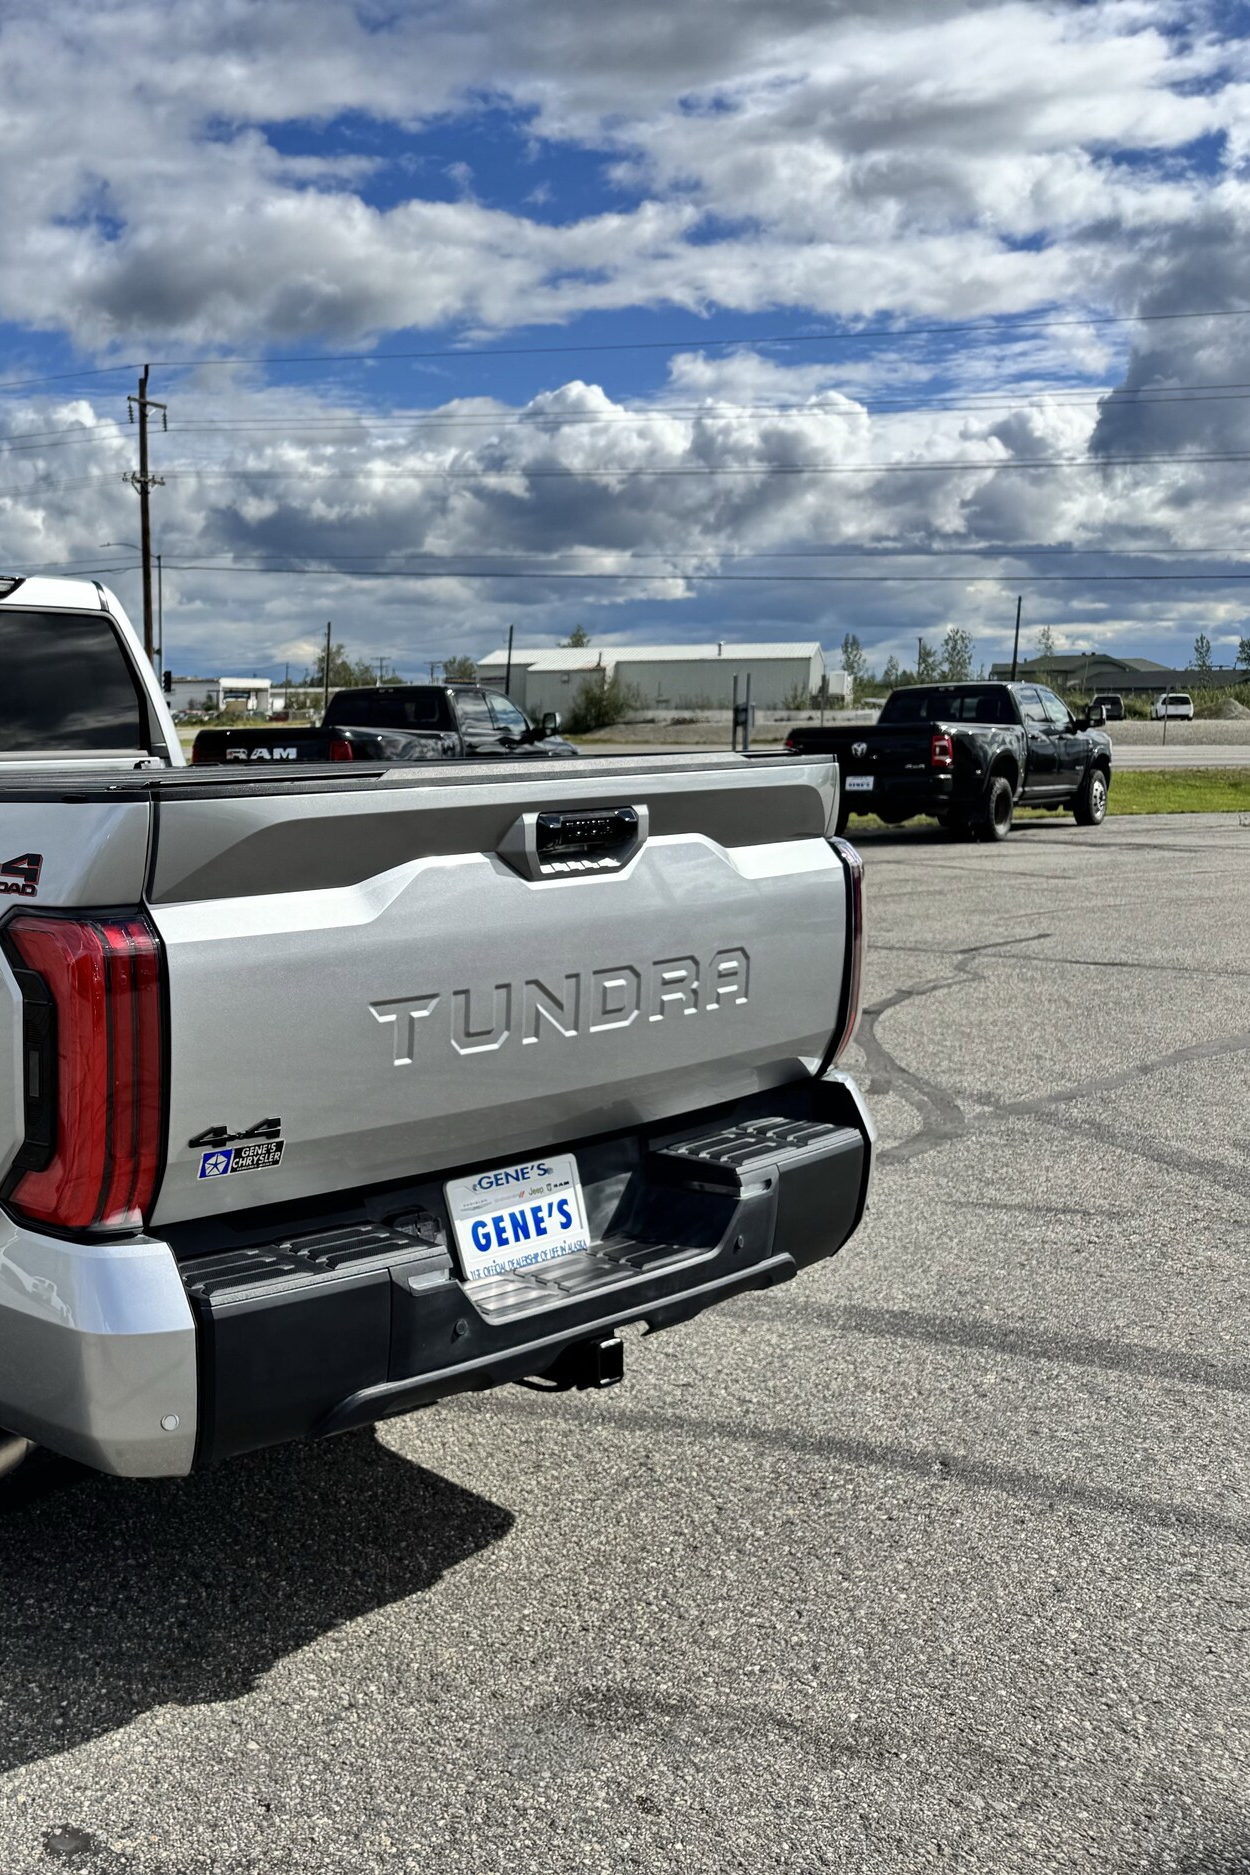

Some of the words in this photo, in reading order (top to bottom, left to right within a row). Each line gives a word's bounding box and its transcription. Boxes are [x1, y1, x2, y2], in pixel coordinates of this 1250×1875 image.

[226, 747, 297, 760] RAM
[368, 946, 750, 1066] TUNDRA
[232, 1151, 281, 1168] CHRYSLER
[241, 1142, 277, 1157] GENE'S
[477, 1163, 548, 1190] GENE'S
[471, 1199, 573, 1252] GENE'S
